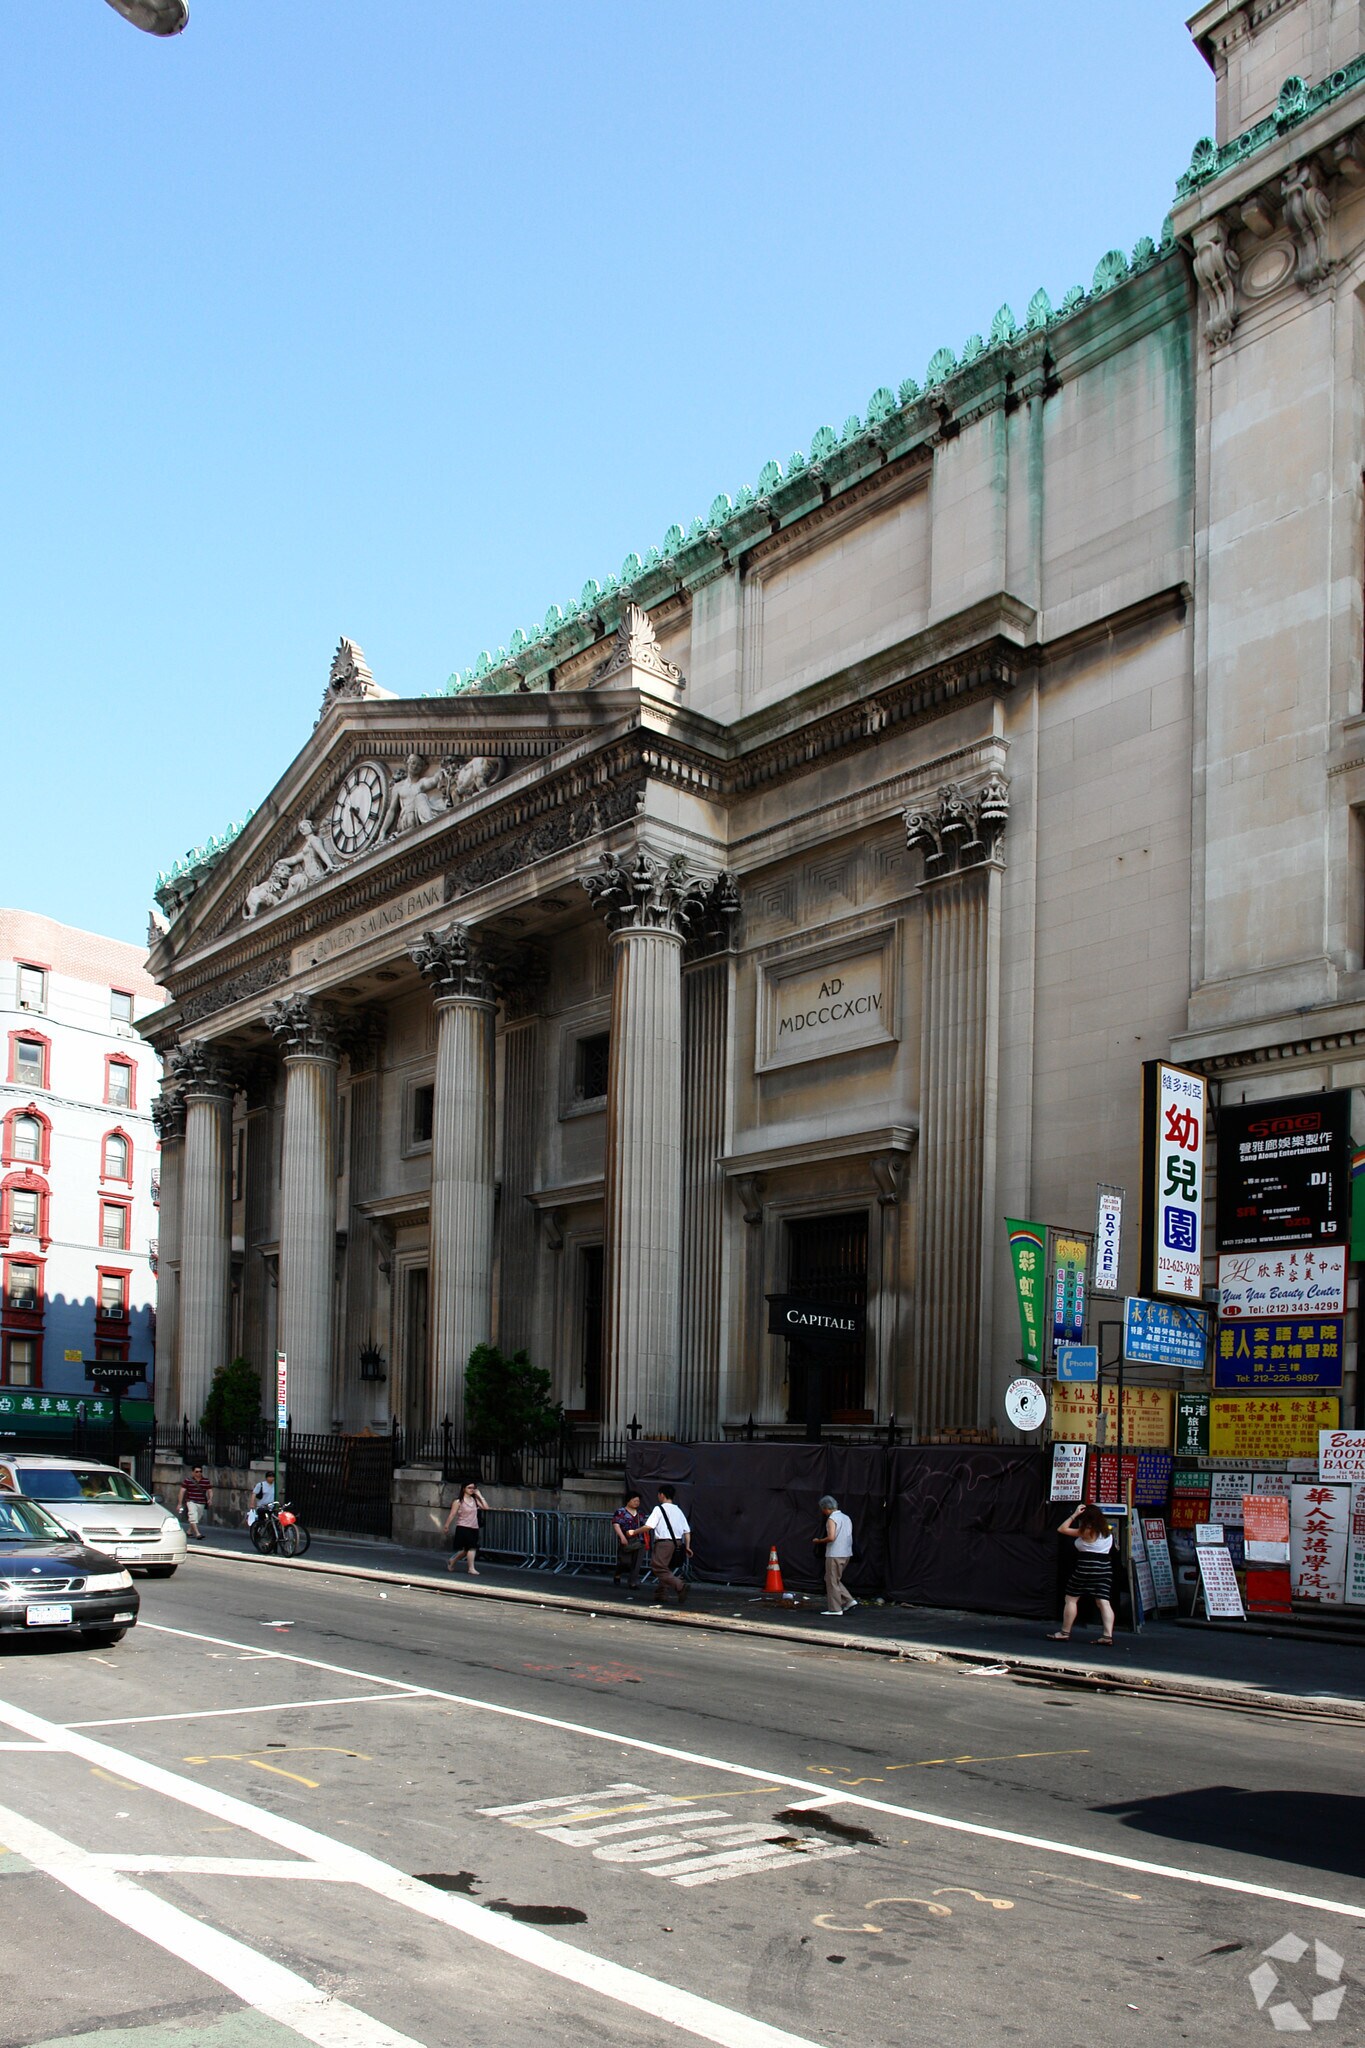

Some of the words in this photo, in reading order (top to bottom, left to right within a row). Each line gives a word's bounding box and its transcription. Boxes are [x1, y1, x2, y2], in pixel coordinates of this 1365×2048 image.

[317, 928, 355, 957] BOWERY
[361, 902, 404, 937] SAVINGS
[1162, 1073, 1203, 1100] 維多利亞
[1240, 1154, 1257, 1162] Sang
[1258, 1150, 1278, 1160] Along
[1279, 1145, 1330, 1157] Entertainment
[1163, 1102, 1200, 1254] 幼兒園
[1311, 1172, 1327, 1186] DJ
[1105, 1213, 1116, 1236] DAY
[1320, 1221, 1337, 1233] L5
[1103, 1240, 1115, 1271] CARE
[1318, 1261, 1342, 1274] 中心
[1164, 1275, 1194, 1293] 二樓
[1222, 1288, 1242, 1304] Yun
[1246, 1287, 1266, 1303] Yau
[1269, 1286, 1305, 1300] Beauty
[1306, 1284, 1341, 1299] Center
[1249, 1305, 1264, 1314] Tel:
[1266, 1304, 1289, 1314] (212)
[1291, 1301, 1339, 1312] 343-4299
[1220, 1328, 1251, 1359] 華人
[1253, 1325, 1337, 1341] 英語學院
[1253, 1343, 1338, 1359] 英數補習班
[1069, 1359, 1094, 1368] Phone
[1253, 1373, 1320, 1383] 212-226-9897
[1186, 1416, 1200, 1446] 旅行社
[1323, 1449, 1365, 1459] FOOT
[1323, 1459, 1365, 1470] BACK
